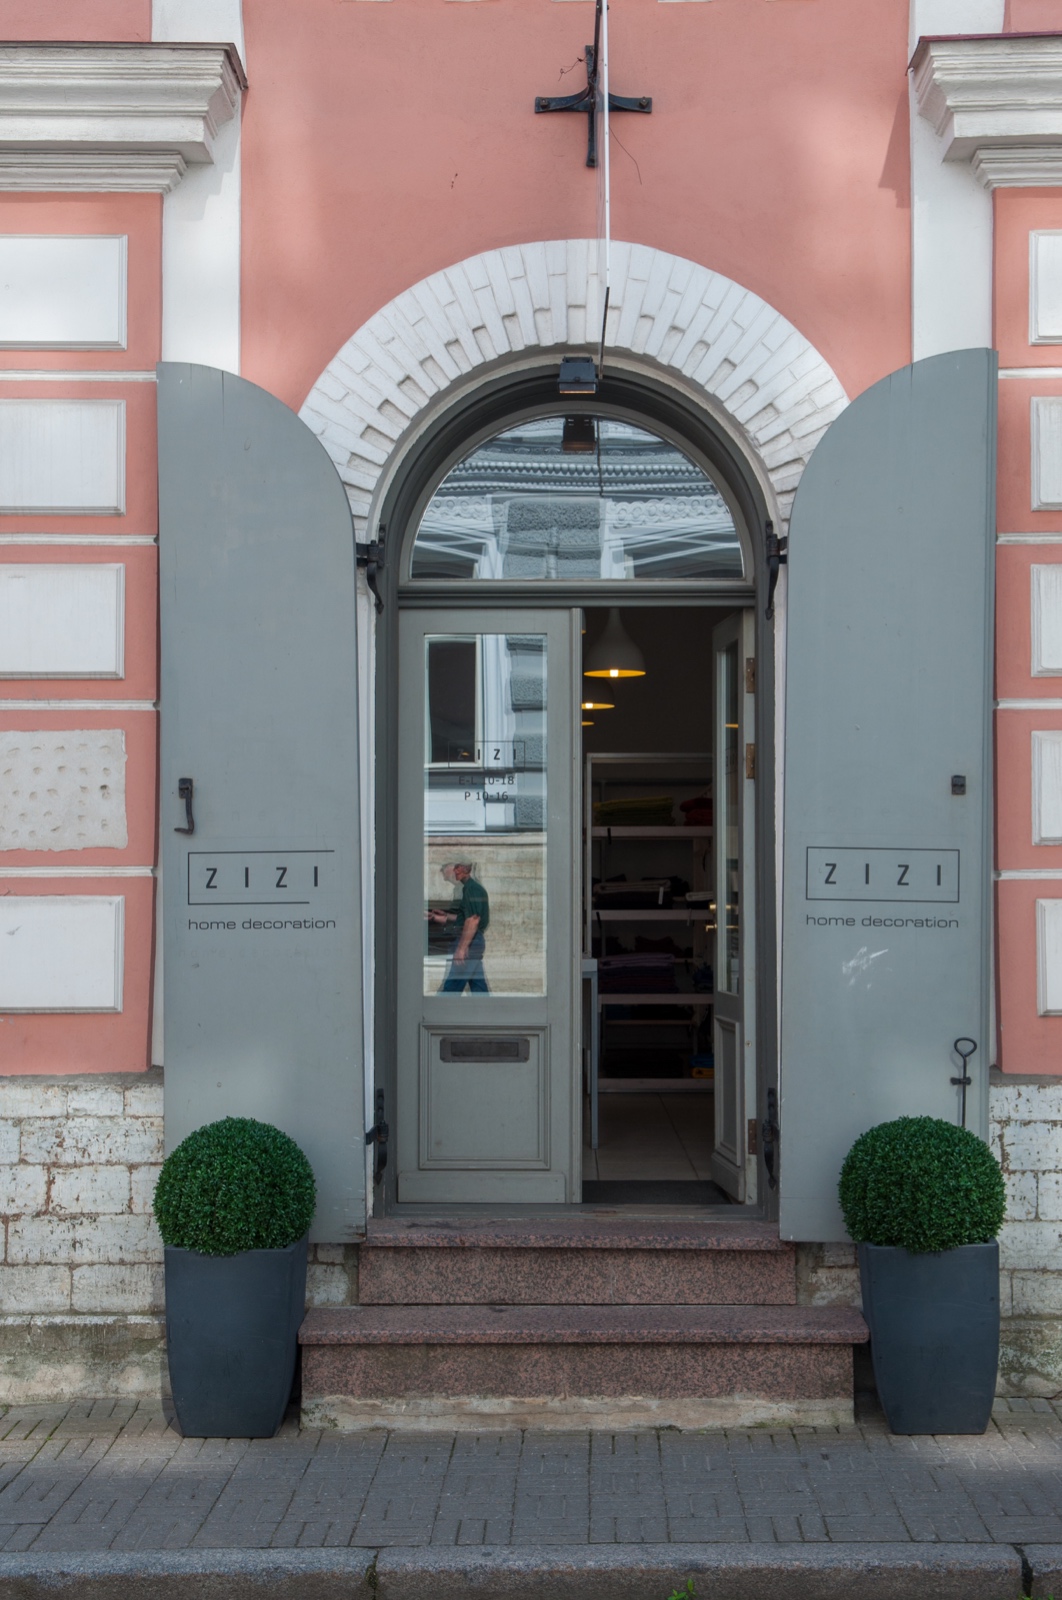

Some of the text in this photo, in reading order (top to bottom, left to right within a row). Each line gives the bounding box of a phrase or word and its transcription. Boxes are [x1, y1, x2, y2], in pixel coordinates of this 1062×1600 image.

[458, 775, 515, 785] E-L 10-18
[464, 791, 509, 801] P 10-16
[205, 866, 319, 889] ZIZI
[824, 863, 942, 886] ZIZI
[188, 917, 336, 930] home decoration
[806, 914, 959, 928] home decoration
